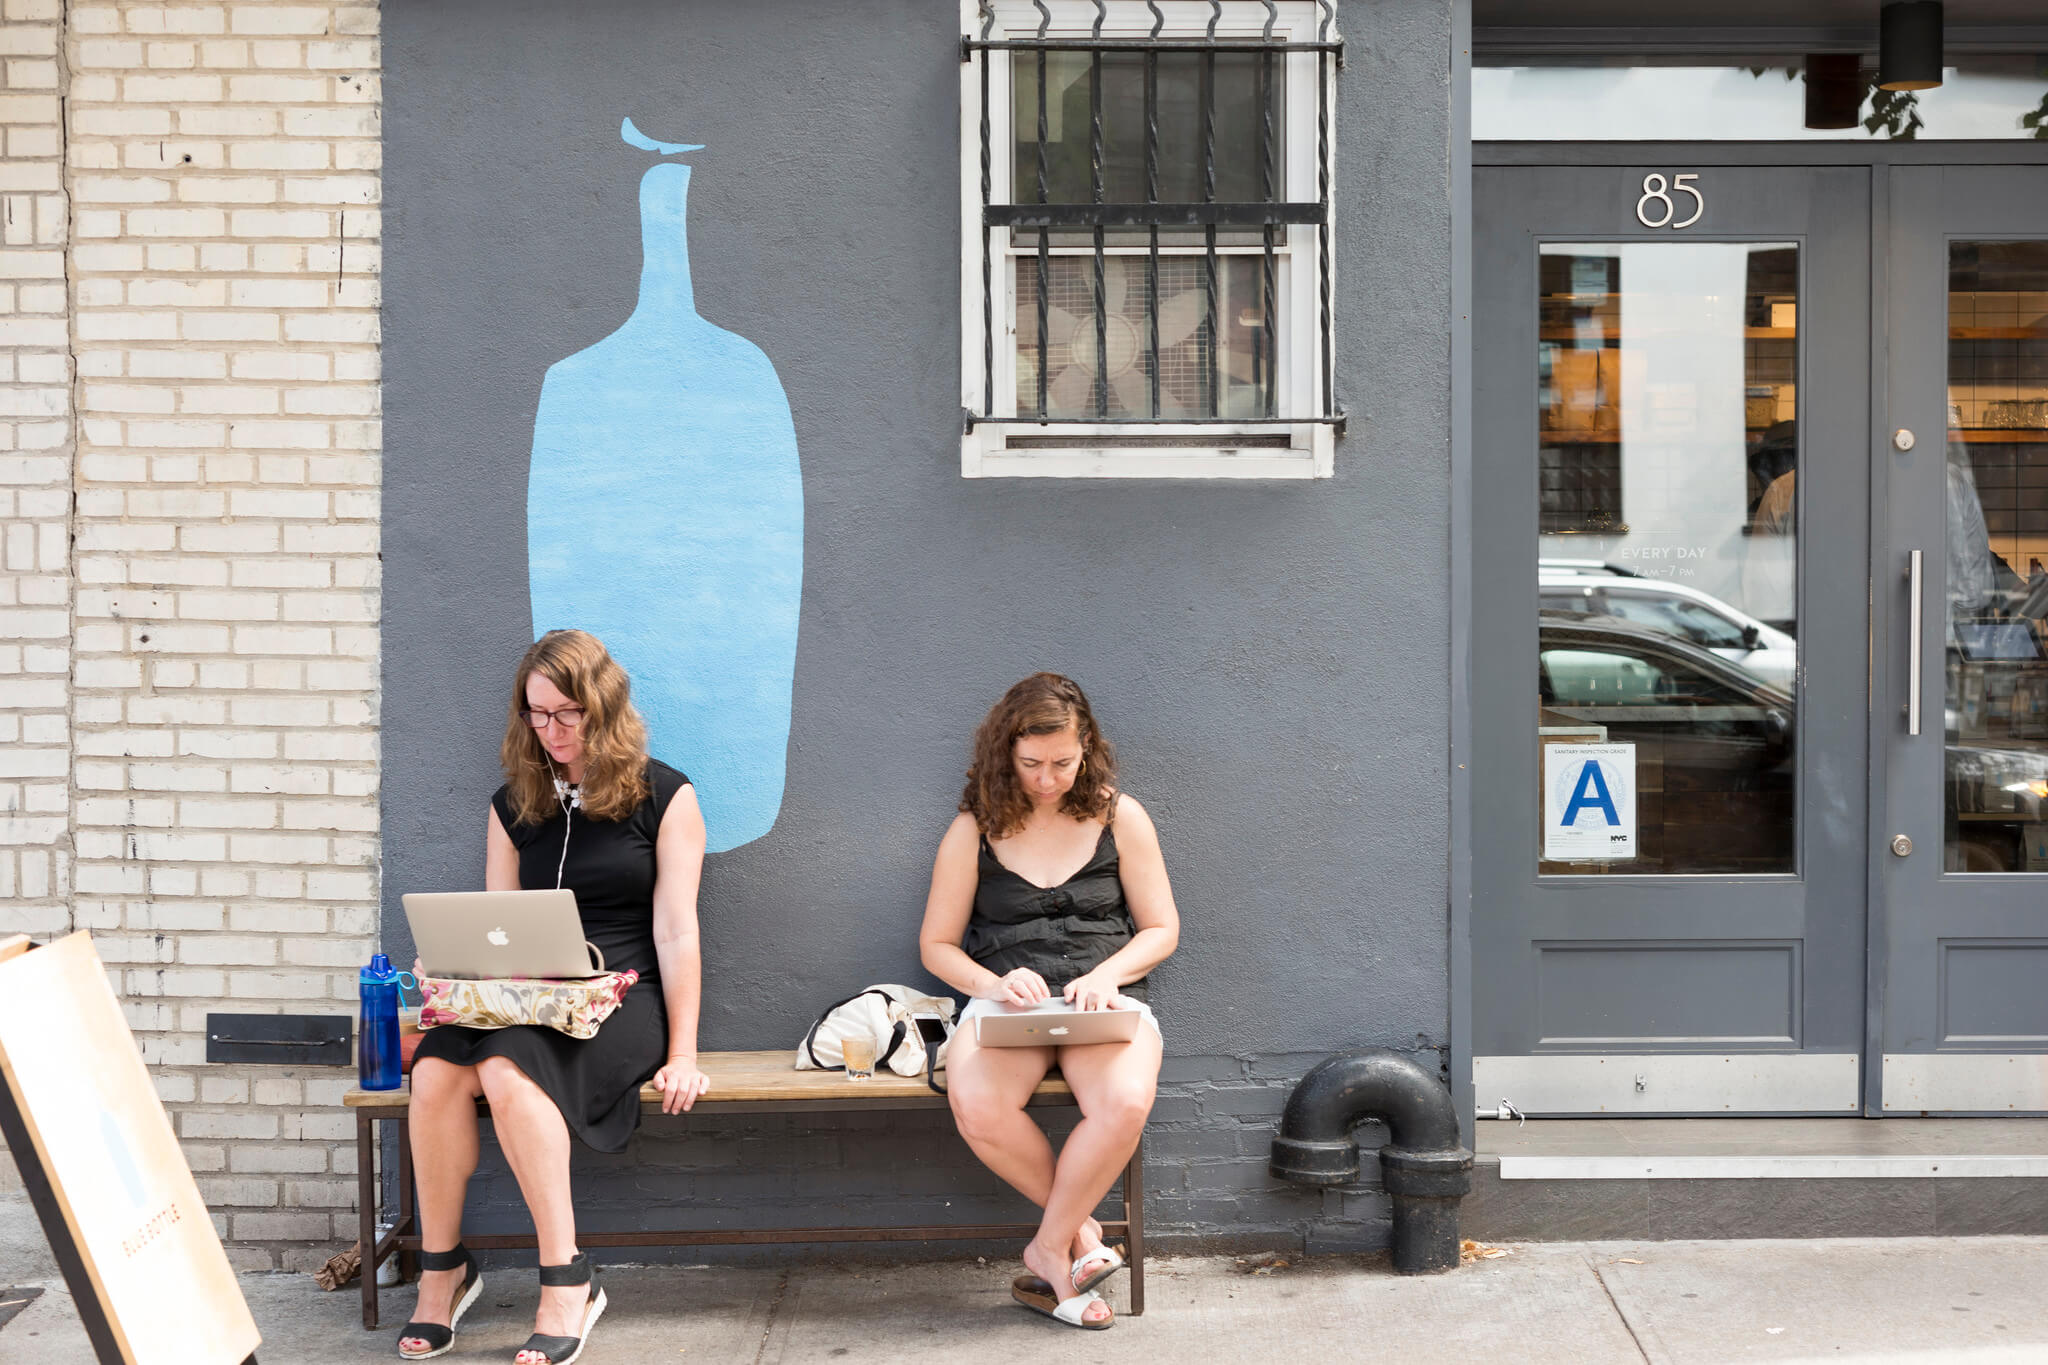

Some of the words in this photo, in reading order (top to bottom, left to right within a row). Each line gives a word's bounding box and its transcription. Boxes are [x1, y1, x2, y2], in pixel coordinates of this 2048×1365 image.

[1636, 172, 1704, 229] 85
[1622, 547, 1670, 559] EVERY
[1677, 547, 1706, 559] DAY
[1632, 566, 1640, 576] 7
[1560, 760, 1621, 826] A
